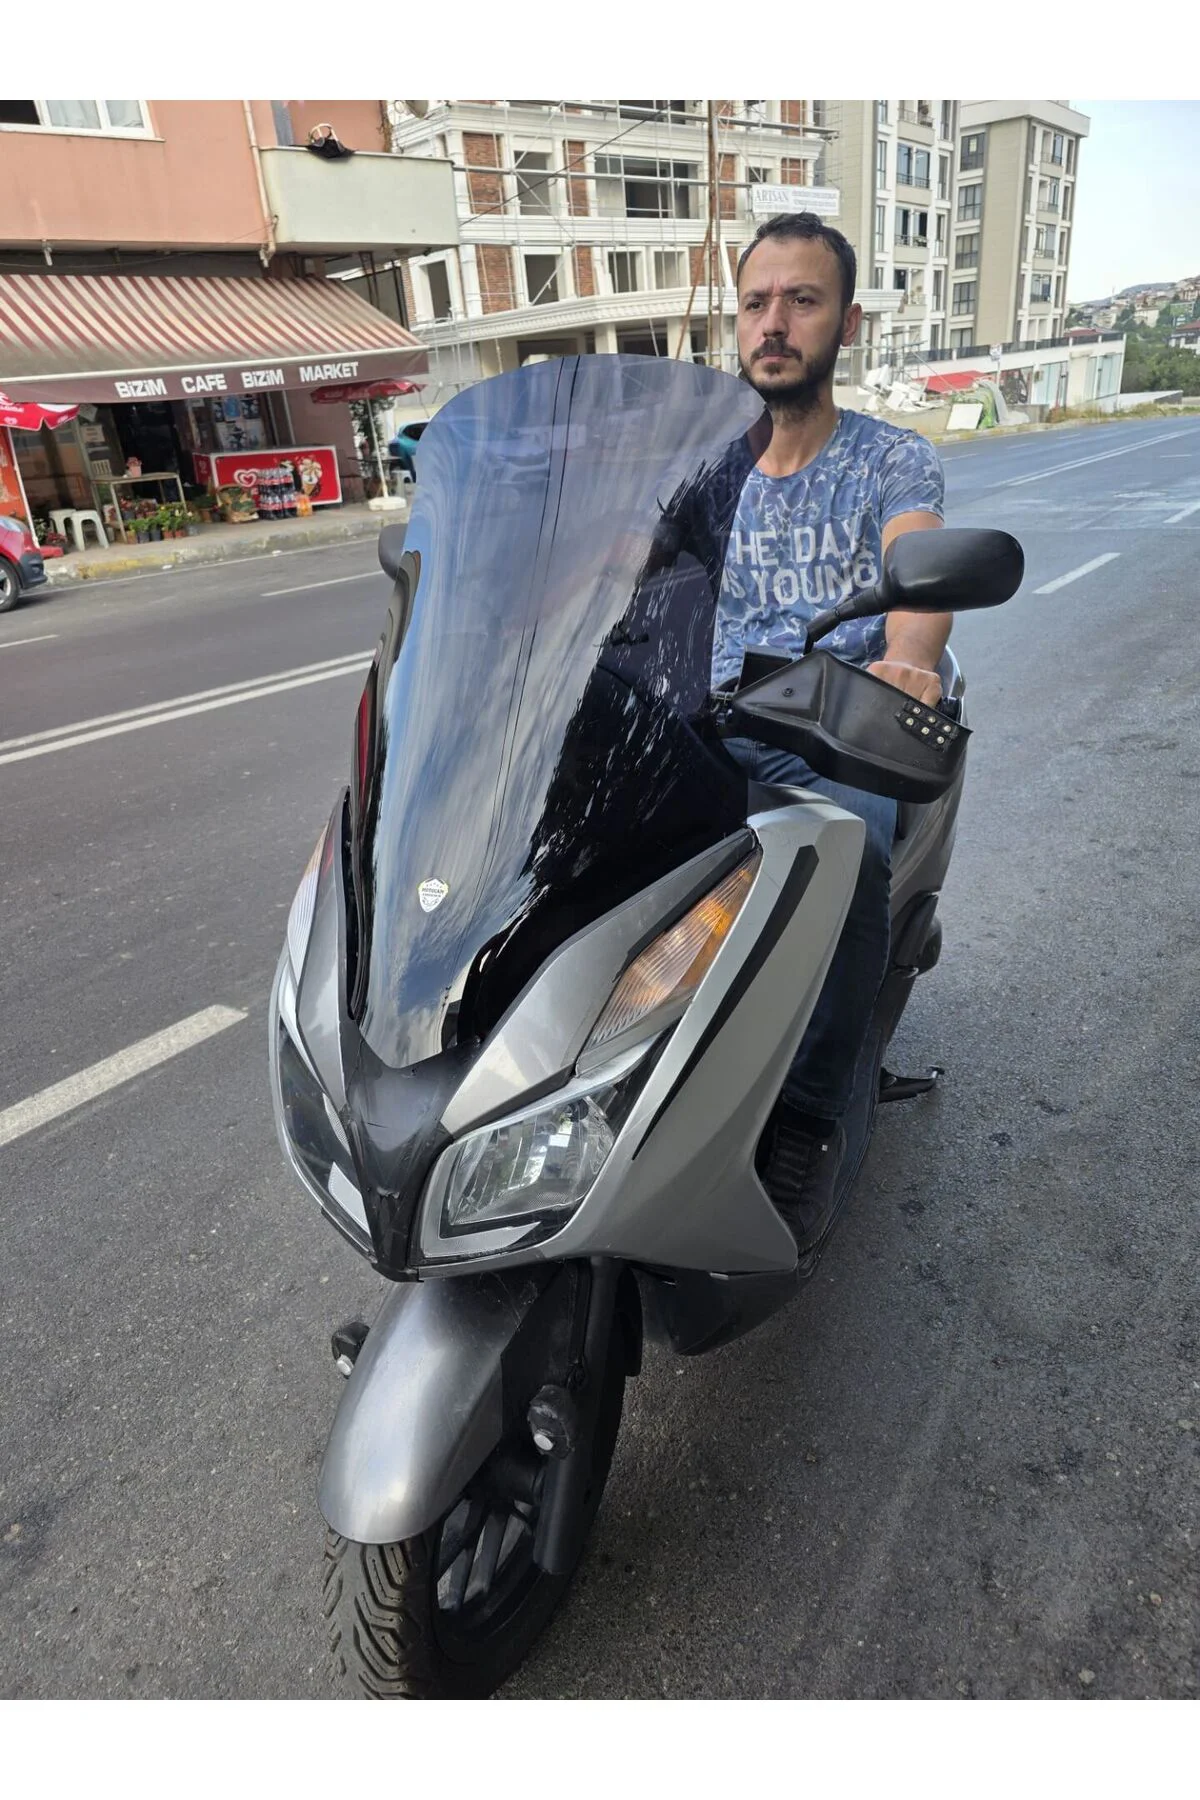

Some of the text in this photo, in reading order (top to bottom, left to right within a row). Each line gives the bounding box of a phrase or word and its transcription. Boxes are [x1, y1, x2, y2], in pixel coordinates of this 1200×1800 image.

[181, 373, 227, 393] CAFE
[299, 361, 359, 382] MARKET
[730, 516, 859, 566] HE DAY
[750, 549, 879, 606] YOUNG
